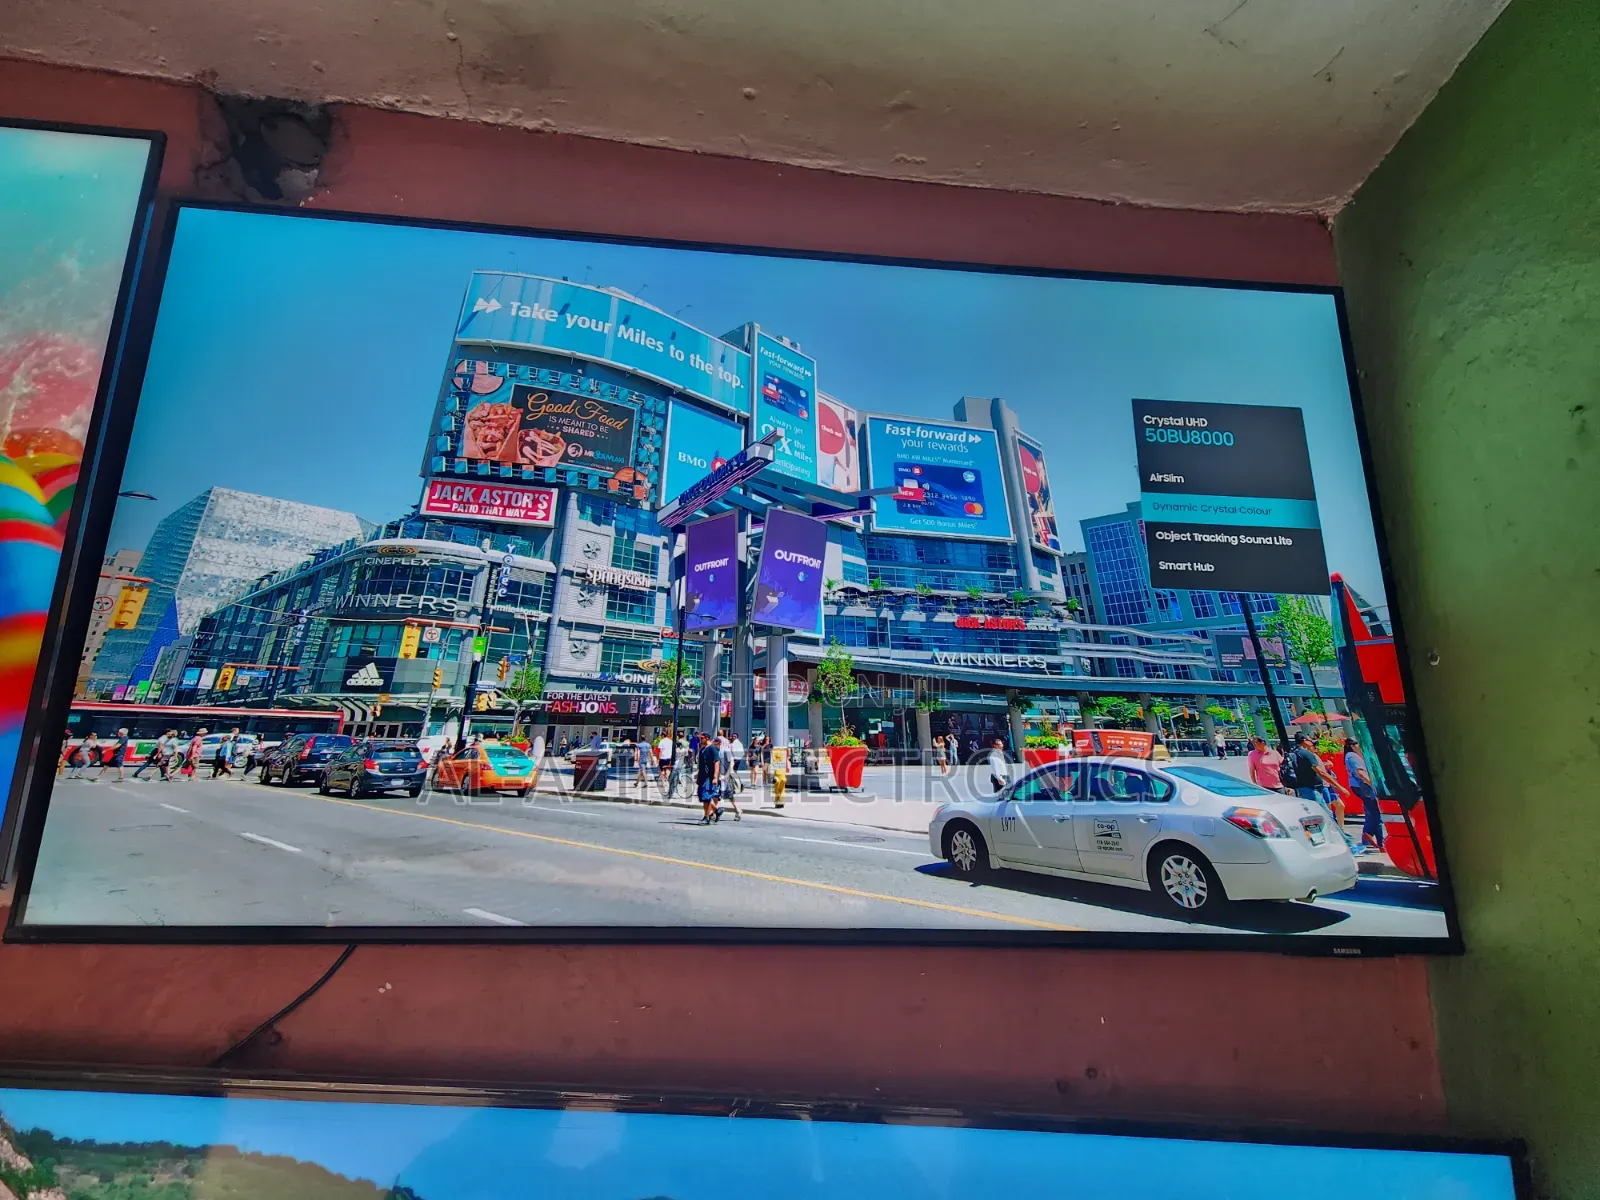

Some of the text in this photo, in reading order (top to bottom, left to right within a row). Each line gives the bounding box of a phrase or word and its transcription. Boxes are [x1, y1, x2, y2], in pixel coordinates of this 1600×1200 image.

[510, 301, 744, 389] Take your Miles to the top.
[760, 347, 805, 374] Fast-forward
[526, 392, 629, 431] Good Food
[558, 417, 585, 428] MEANT
[587, 423, 598, 431] TO
[600, 426, 609, 434] BE
[1143, 415, 1208, 428] Crystal UHD
[562, 425, 595, 438] SHARED
[793, 424, 804, 435] get
[885, 424, 966, 442] Fast-forward
[1145, 428, 1235, 446] 50BU8000
[794, 440, 805, 450] the
[901, 438, 968, 453] your rewards
[678, 452, 707, 468] BMO
[794, 449, 813, 463] Miles
[774, 459, 810, 477] articipating
[1149, 473, 1184, 483] AirSlim
[432, 485, 549, 509] JACK ASTOR'S
[451, 503, 526, 518] PATIO THAT WAY
[1153, 502, 1272, 516] Dynamic Crystal Colour
[1155, 531, 1293, 546] Object Tracking Sound Lite
[365, 557, 431, 566] CINEPLEX
[694, 557, 729, 572] OUTFRONT
[775, 550, 822, 569] OUTFRONT
[1158, 561, 1215, 572] Smart Hub
[336, 594, 458, 611] WINNERS
[934, 652, 1047, 668] WINNERS
[547, 692, 564, 700] FOR
[584, 693, 612, 702] LATEST
